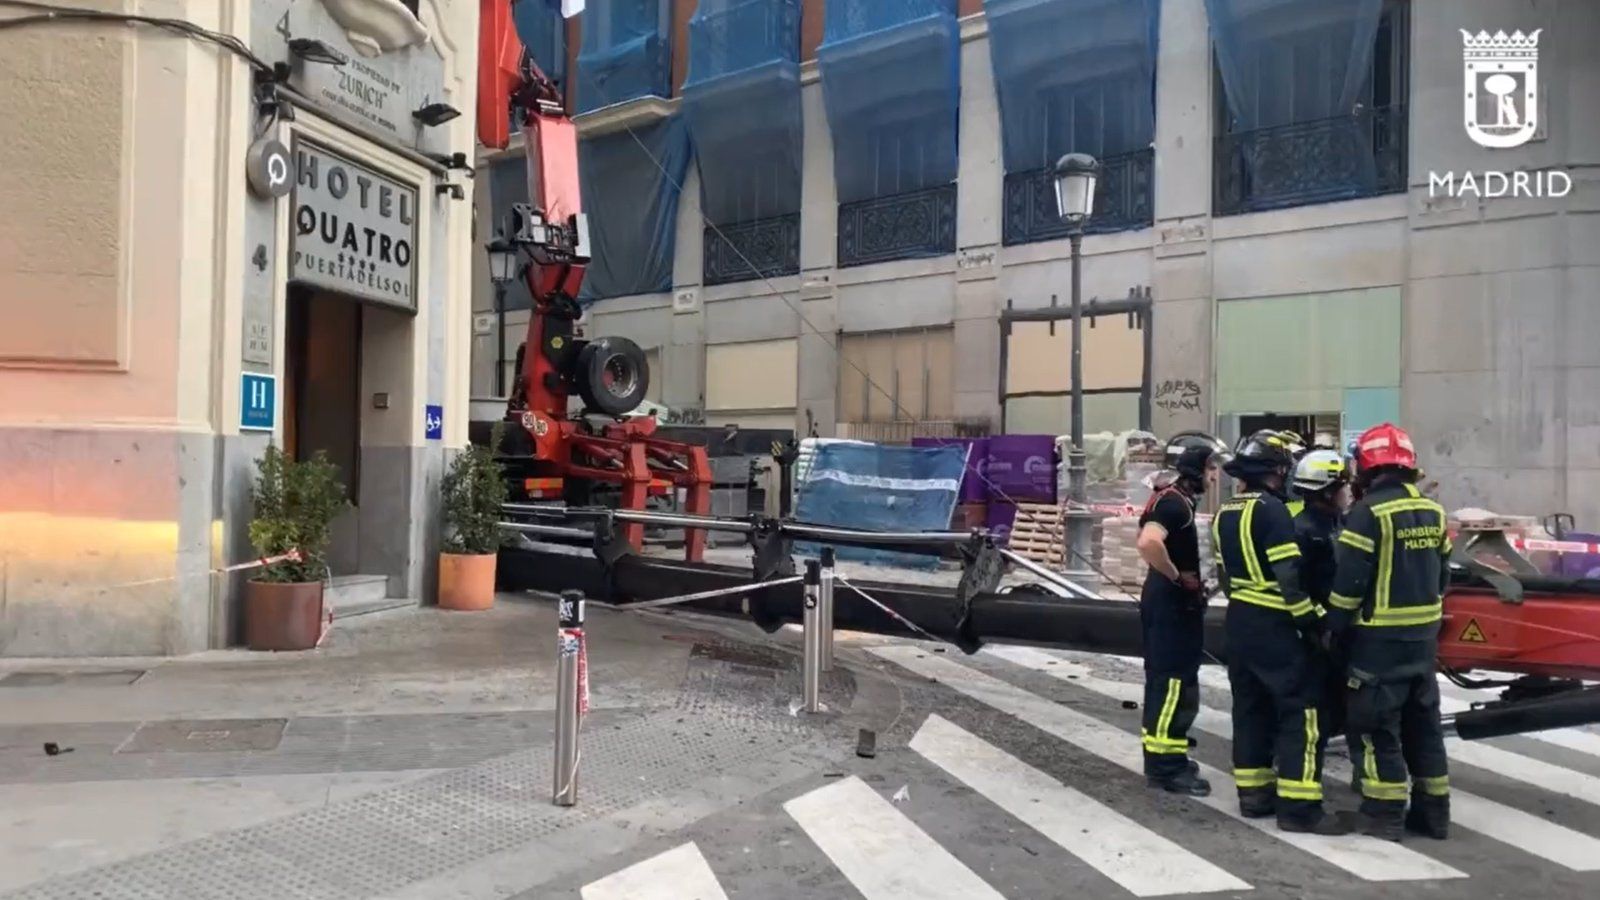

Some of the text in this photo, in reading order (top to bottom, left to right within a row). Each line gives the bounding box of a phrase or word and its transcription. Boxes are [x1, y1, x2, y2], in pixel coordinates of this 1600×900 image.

[276, 9, 291, 43] 4
[298, 151, 412, 225] HOTEL
[297, 204, 411, 267] QUATRO
[252, 243, 268, 272] 4
[251, 380, 267, 409] H
